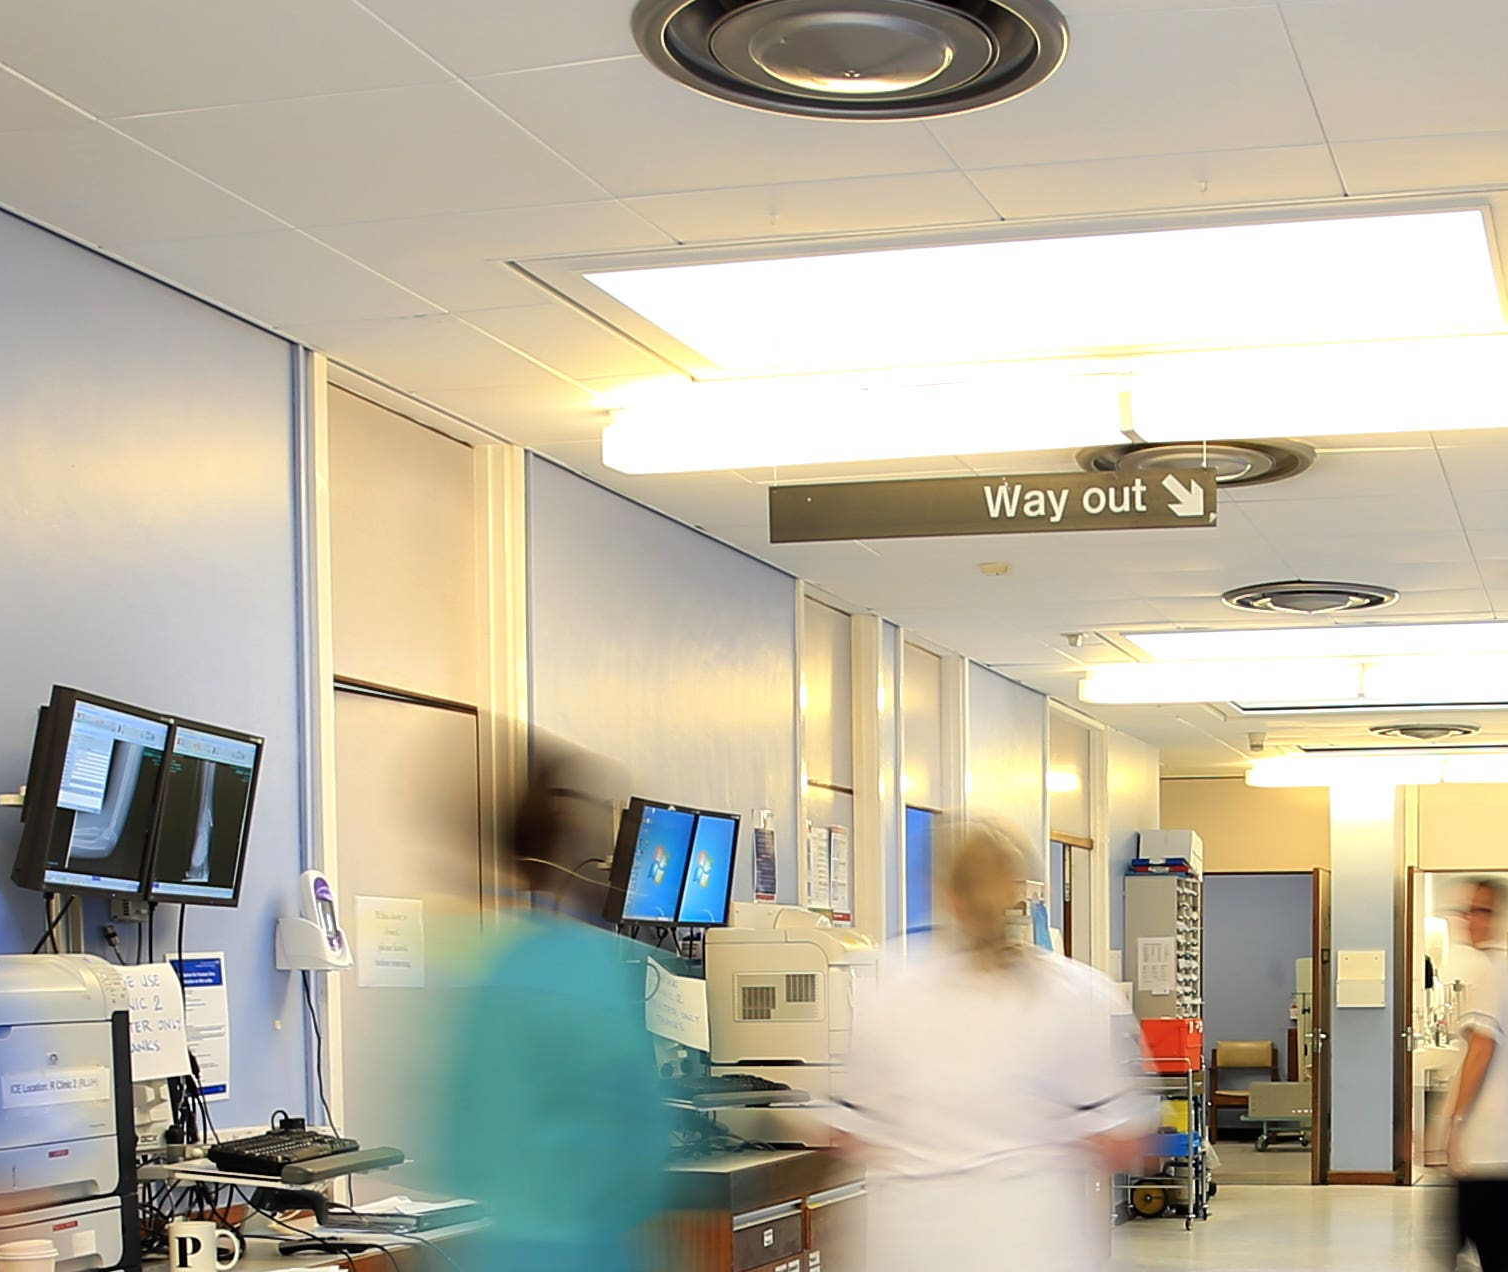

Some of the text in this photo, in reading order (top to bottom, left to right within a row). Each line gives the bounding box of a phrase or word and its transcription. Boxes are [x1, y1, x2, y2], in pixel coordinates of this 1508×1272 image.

[984, 478, 1147, 522] Way out
[142, 974, 161, 988] USE
[129, 994, 163, 1011] NIC 2
[130, 1039, 161, 1054] ANKS
[175, 1236, 202, 1268] P
